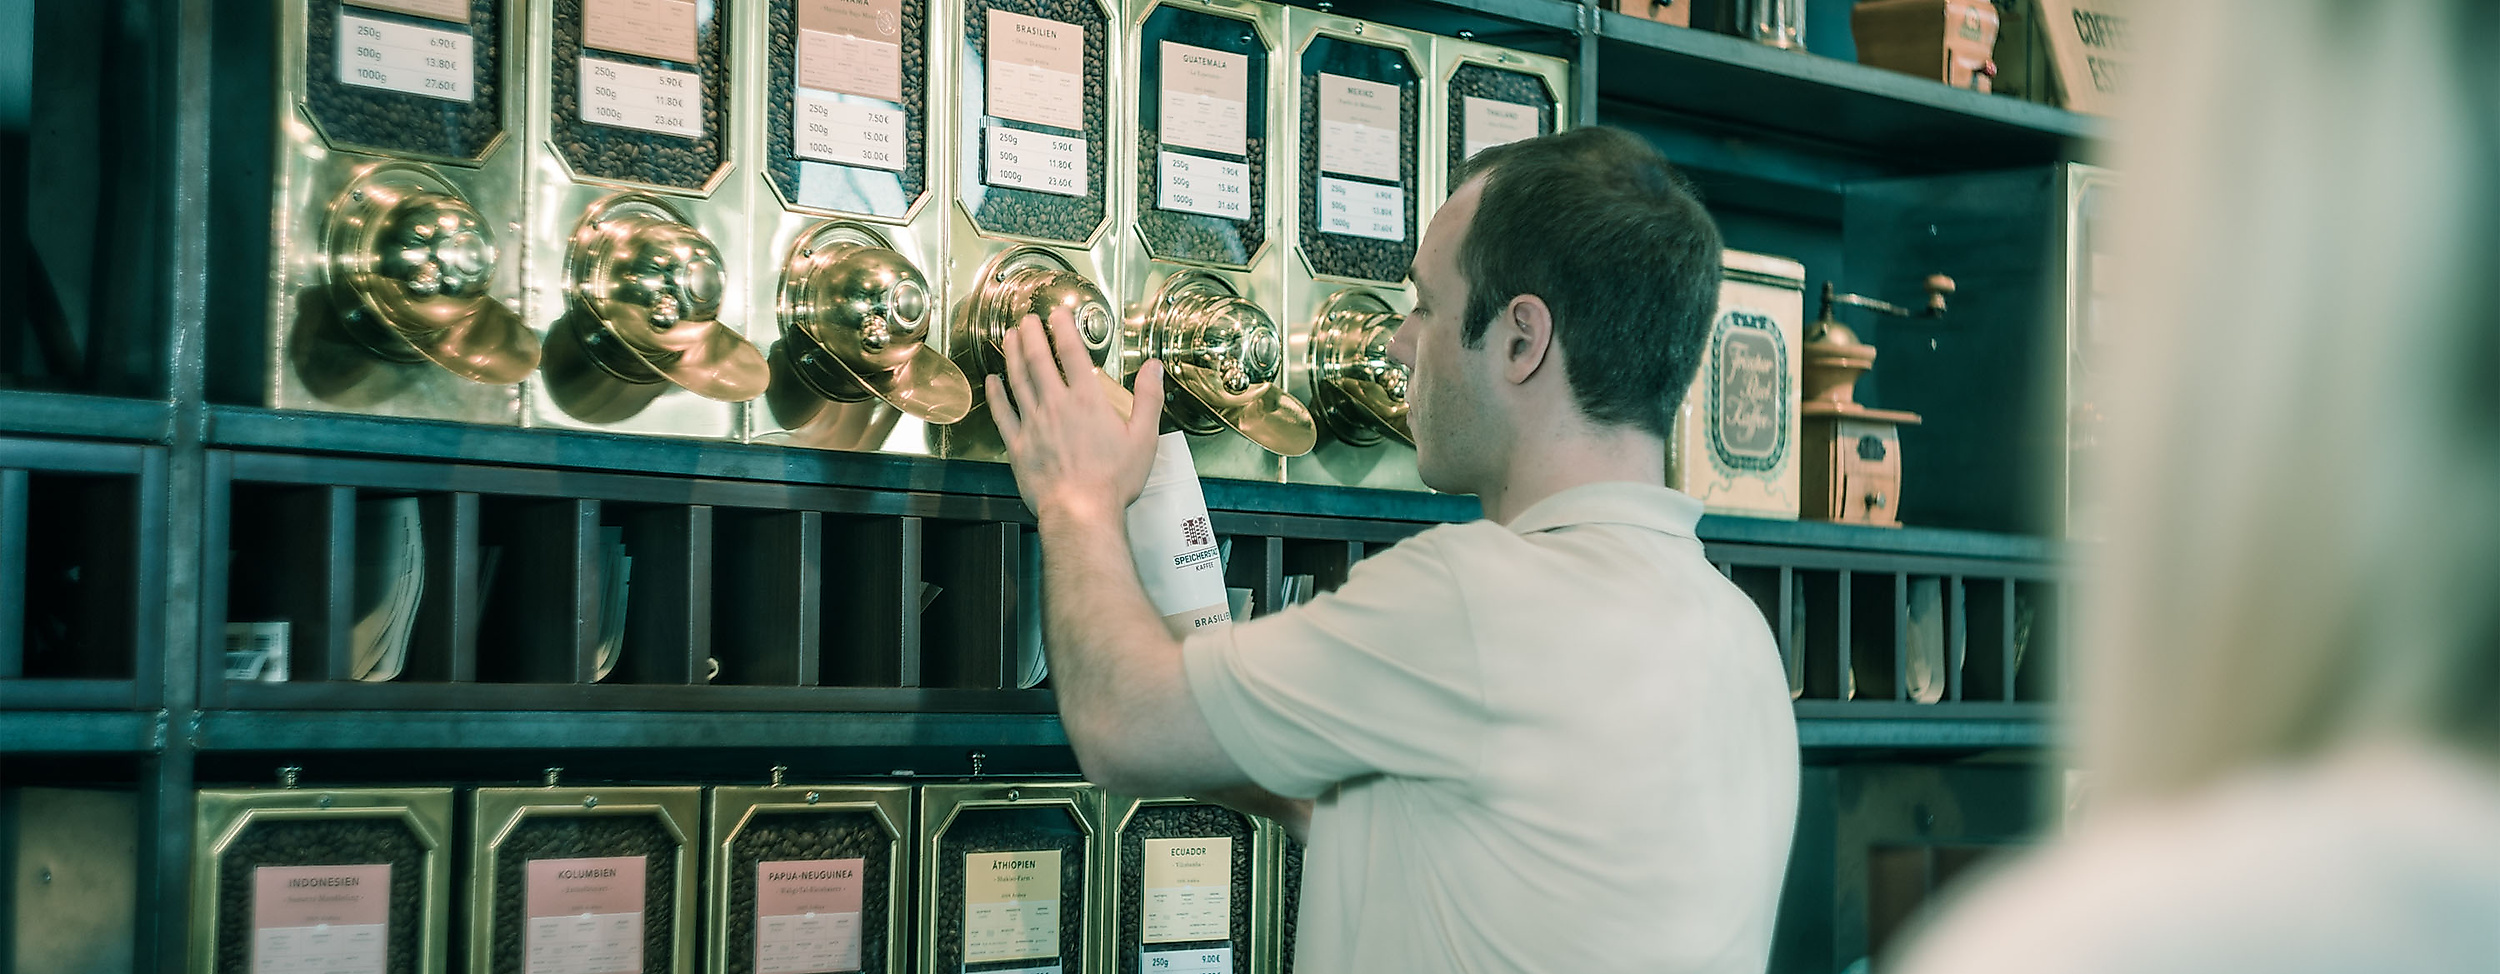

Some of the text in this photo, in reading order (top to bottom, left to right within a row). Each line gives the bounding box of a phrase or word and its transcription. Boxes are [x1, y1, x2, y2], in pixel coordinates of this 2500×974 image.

[357, 25, 457, 50] 250g 6.90€
[1016, 23, 1057, 39] BRASILIEN
[2071, 6, 2131, 51] COFFE
[357, 46, 457, 71] 500g 13.80€
[1183, 53, 1227, 69] GUATEMALA
[357, 68, 457, 92] 1000g 27.60€
[595, 66, 683, 88] 250g 5.90€
[595, 86, 683, 108] 500g 11.80€
[596, 107, 684, 127] 1000g 23.60€
[809, 103, 889, 125] 250g 7.50€
[809, 122, 889, 143] 500g 15.00€
[999, 132, 1073, 152] 250g 5.90€
[862, 150, 889, 162] 30.00€
[999, 151, 1073, 171] 500g 11.80€
[1172, 159, 1189, 171] 250g
[999, 169, 1073, 188] 1000g 23.60€
[1173, 176, 1239, 194] 500g 15.80€
[1173, 194, 1193, 207] 1000g
[1195, 561, 1214, 572] KAFFEE
[1170, 847, 1207, 857] ECUADOR
[558, 868, 617, 879] KOLUMBIEN
[992, 859, 1036, 870] ÄTHIOPIEN
[288, 877, 360, 888] INDONESIEN
[769, 870, 853, 881] PAPUA-NEUGUINEA
[1152, 954, 1221, 968] 250g 9.00€
